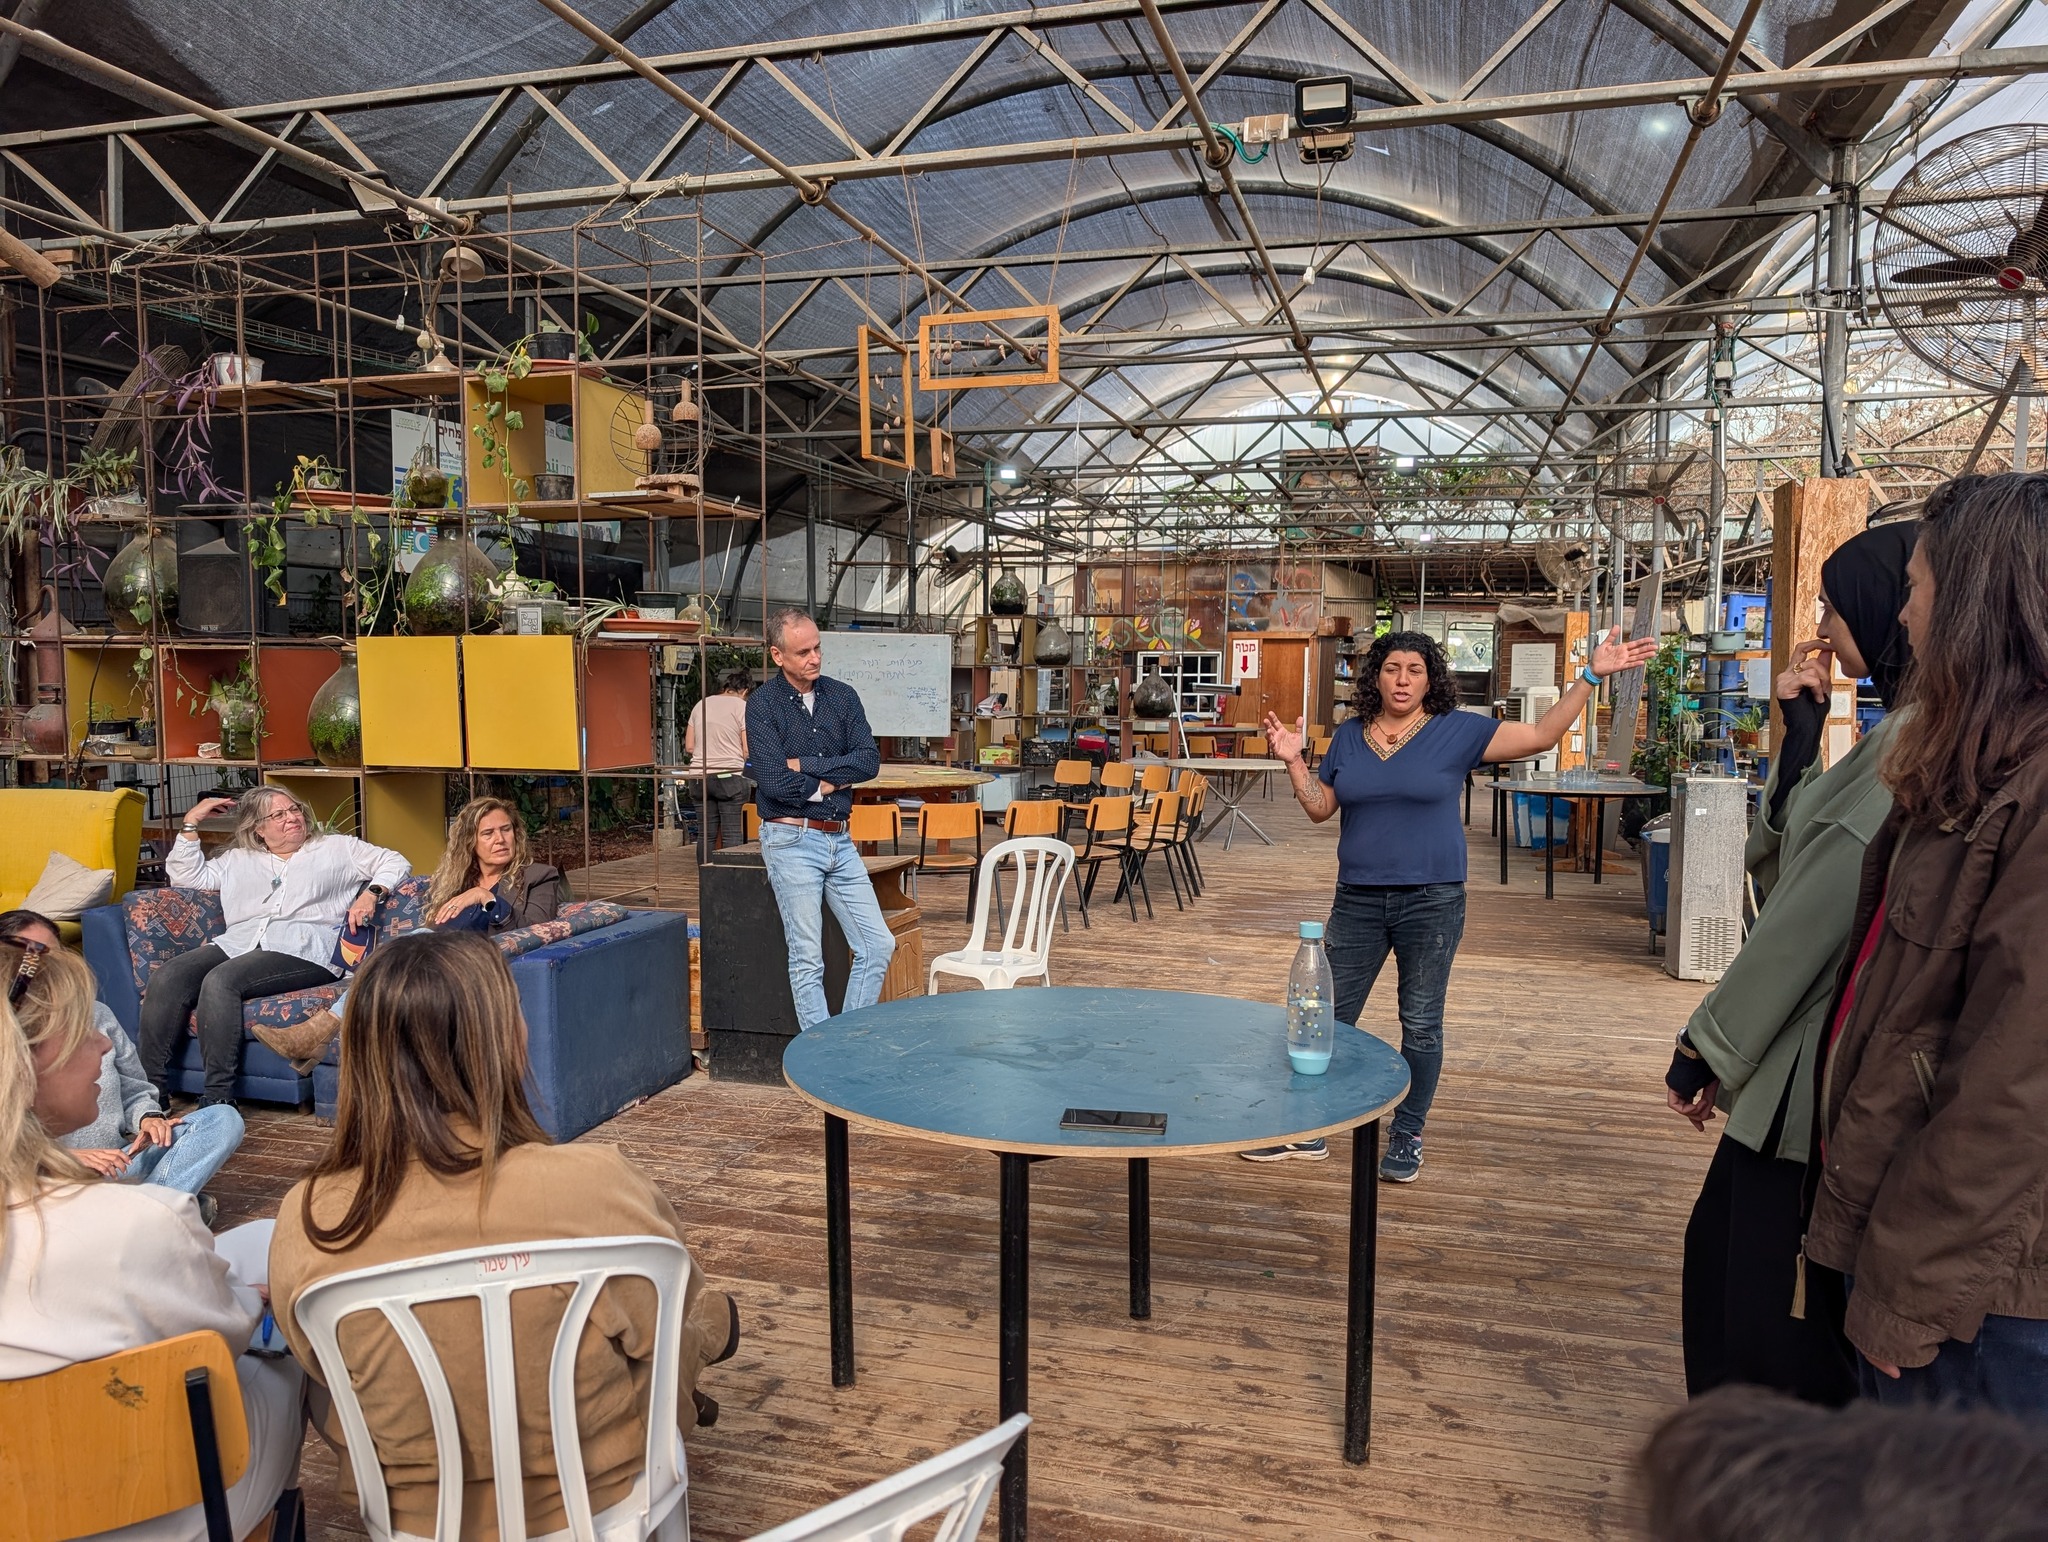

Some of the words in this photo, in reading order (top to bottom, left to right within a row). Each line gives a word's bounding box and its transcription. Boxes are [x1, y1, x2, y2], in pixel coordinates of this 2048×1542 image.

[1235, 643, 1256, 653] מטף
[479, 1255, 508, 1273] שמר
[511, 1251, 531, 1272] עין
